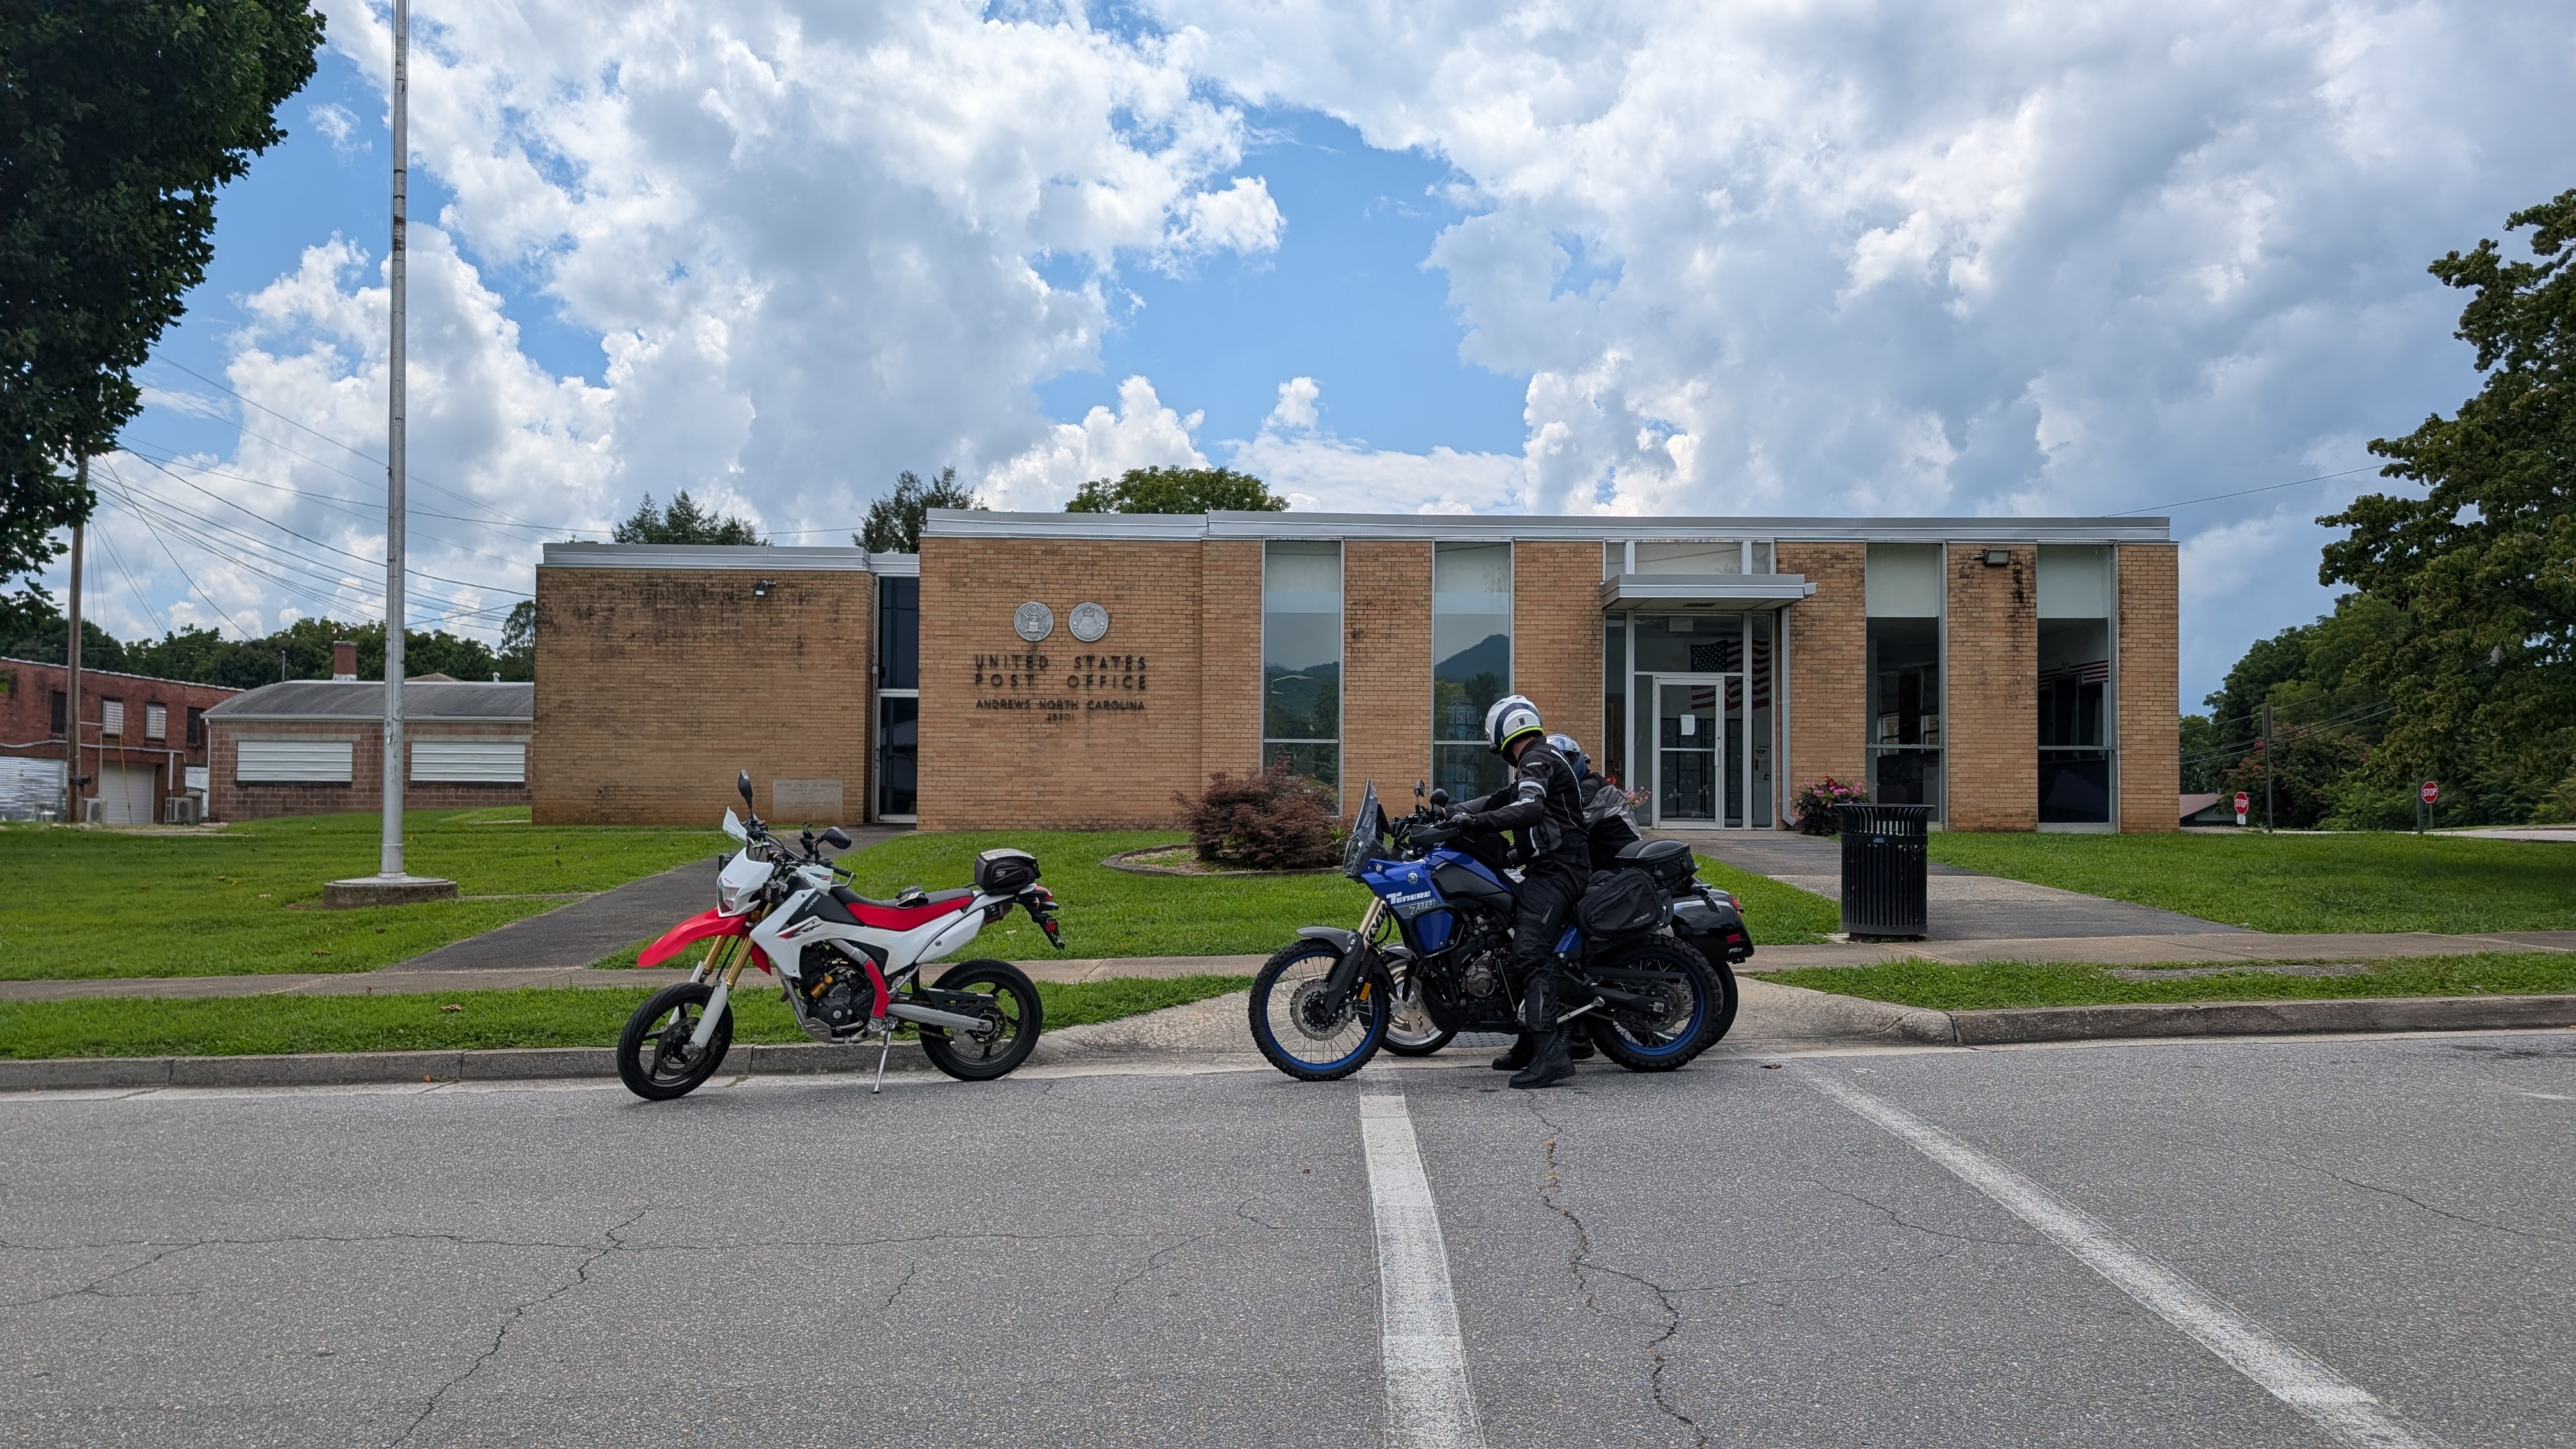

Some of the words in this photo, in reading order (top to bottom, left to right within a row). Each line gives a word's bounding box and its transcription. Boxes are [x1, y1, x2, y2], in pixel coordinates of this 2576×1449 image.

[975, 655, 1048, 670] UNITED
[1074, 656, 1146, 671] STATES
[975, 673, 1034, 687] POST
[1067, 675, 1146, 689] OFFICE
[976, 700, 1030, 709] ANDREWS
[1039, 700, 1078, 710] NORTH
[1087, 700, 1145, 710] CAROLINA
[2423, 788, 2437, 797] STOP
[2235, 799, 2248, 808] STOP
[1409, 898, 1436, 916] 700
